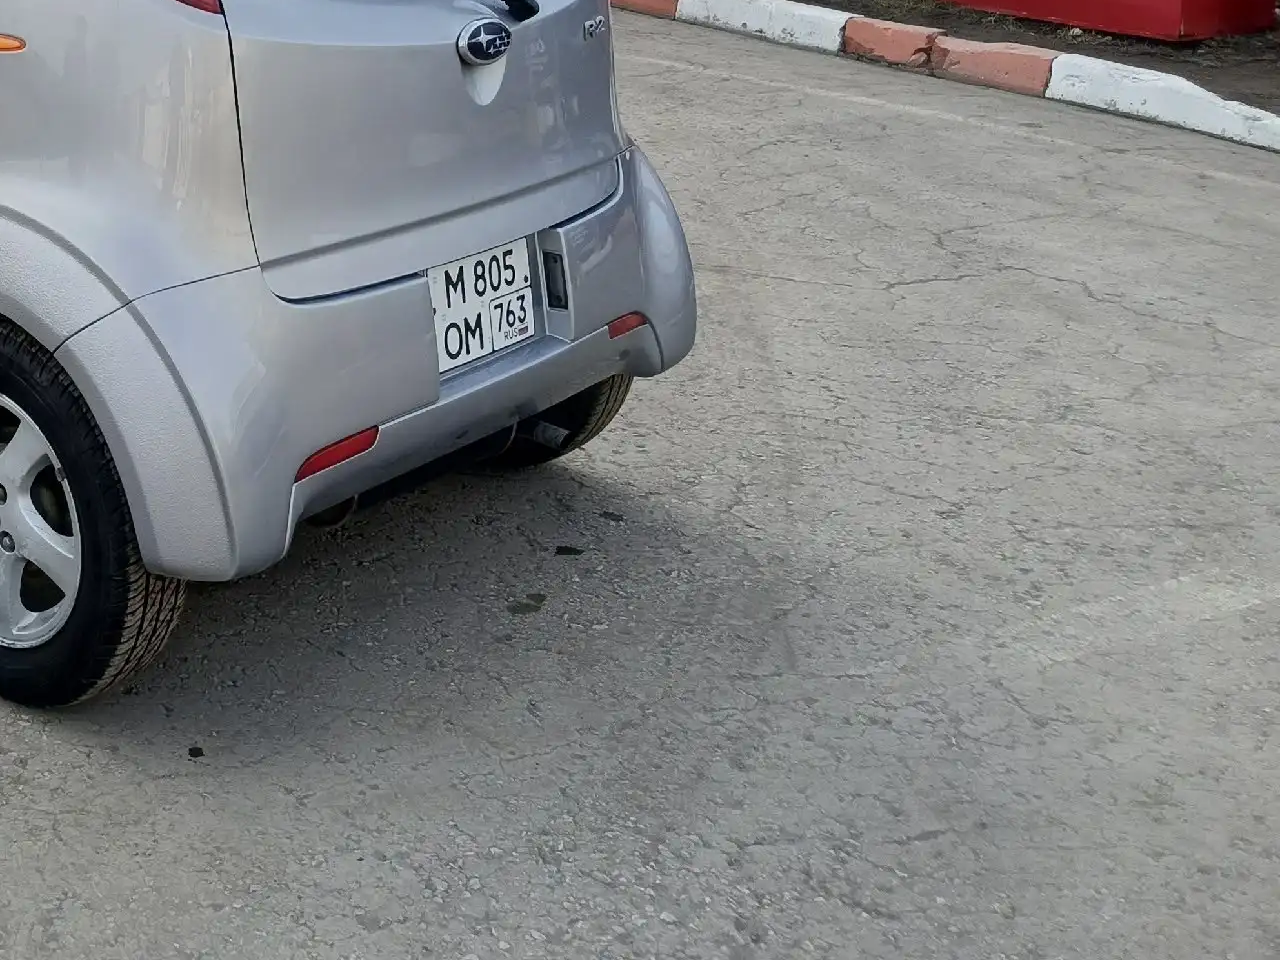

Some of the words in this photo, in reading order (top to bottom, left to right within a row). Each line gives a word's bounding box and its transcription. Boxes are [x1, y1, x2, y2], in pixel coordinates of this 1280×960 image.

[583, 15, 606, 41] R2
[444, 265, 466, 308] М
[473, 248, 516, 297] 805
[493, 294, 527, 332] 763
[444, 311, 484, 360] ОМ
[504, 327, 518, 340] RUS
